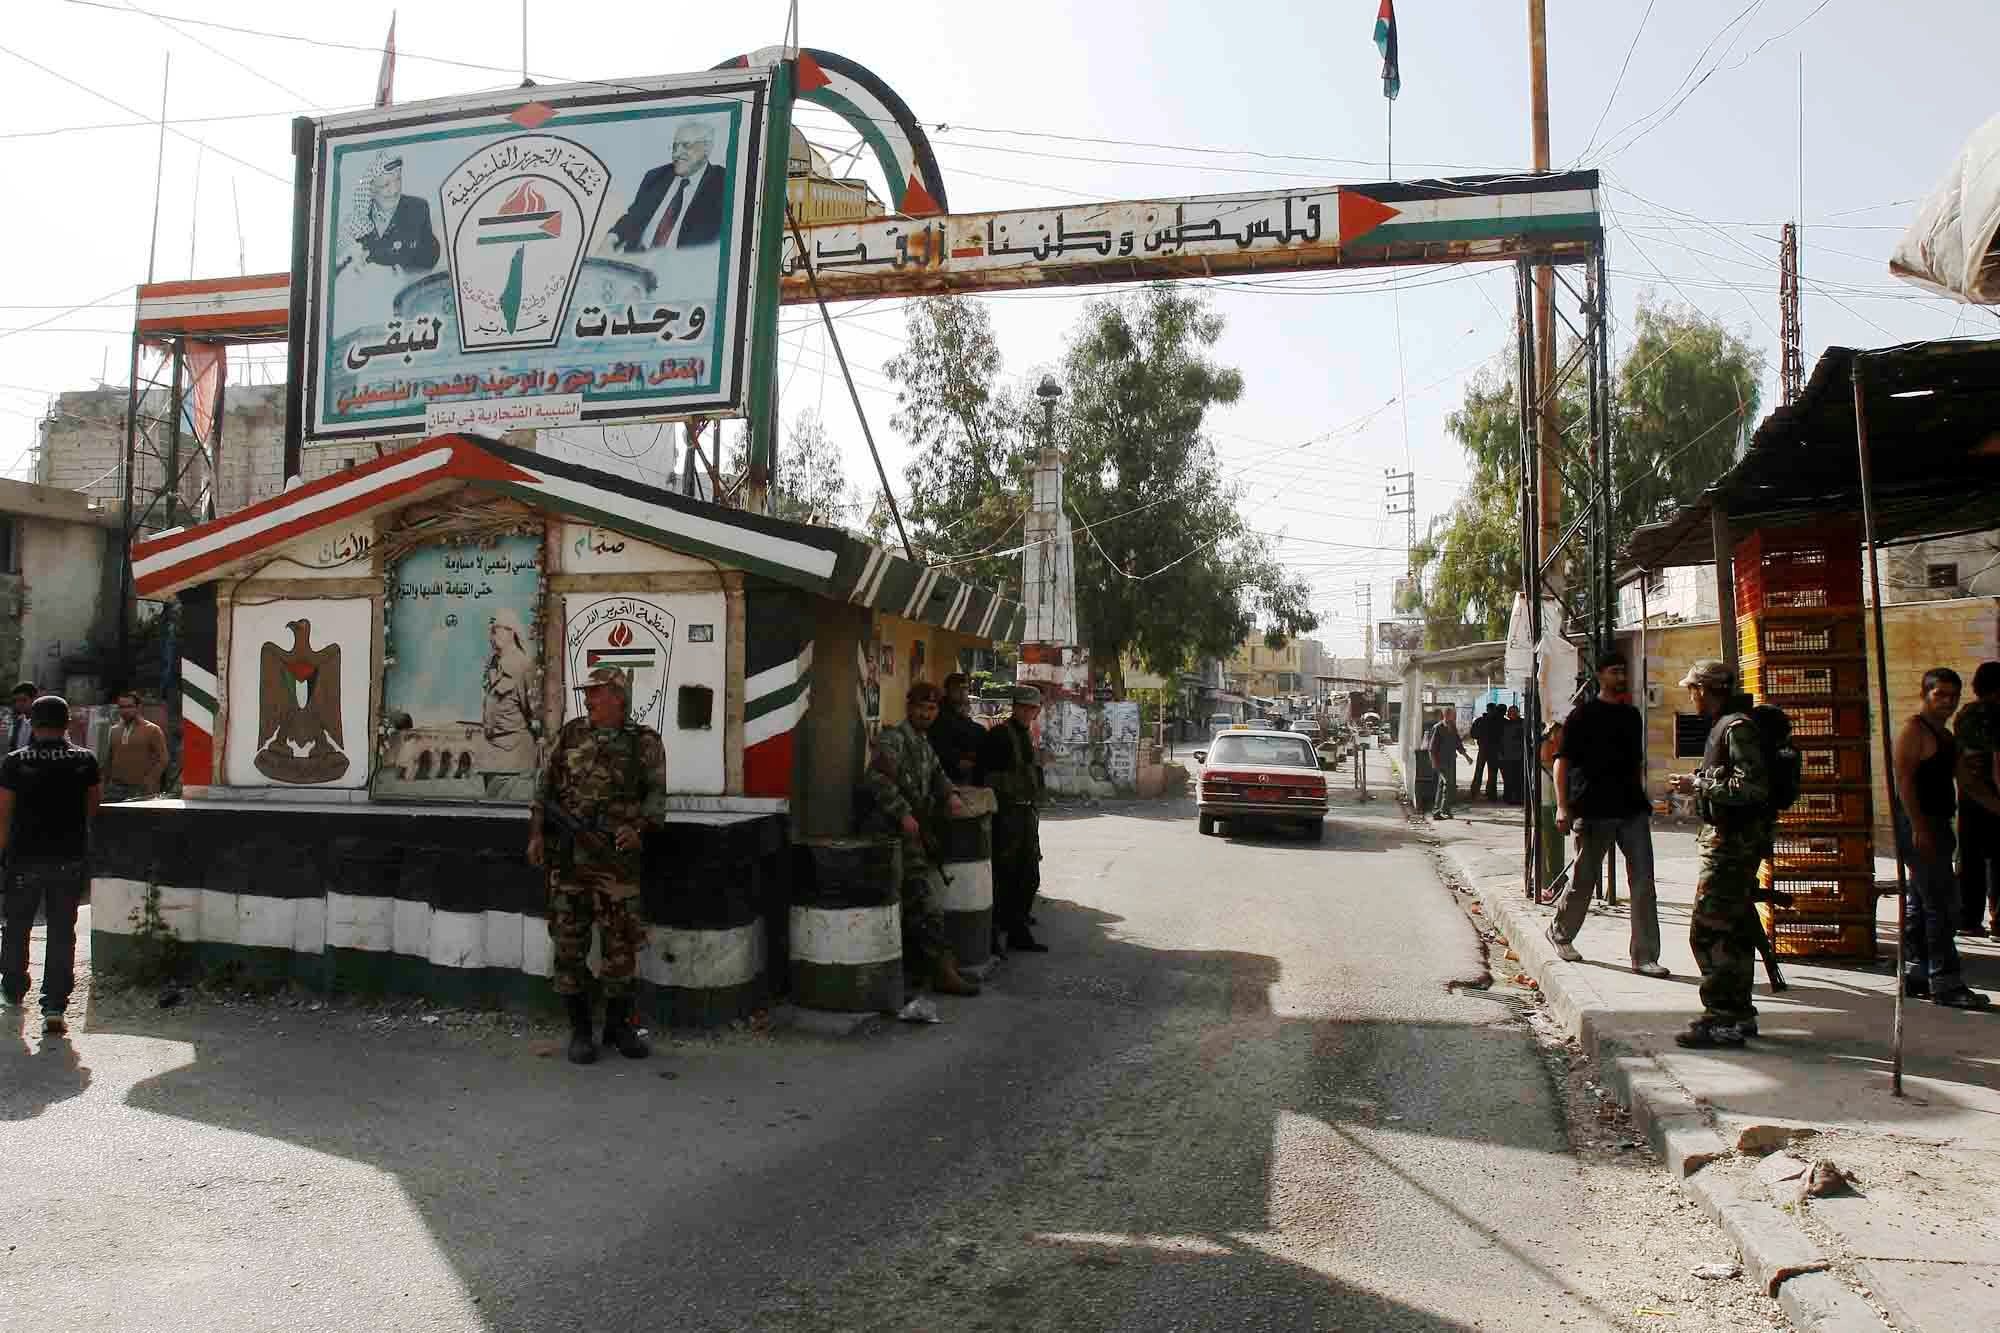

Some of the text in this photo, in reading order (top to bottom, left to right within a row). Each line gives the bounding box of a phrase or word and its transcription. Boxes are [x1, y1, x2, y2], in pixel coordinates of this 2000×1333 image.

[1143, 196, 1321, 254] فلسطين
[347, 304, 706, 370] وجدت لتبقى
